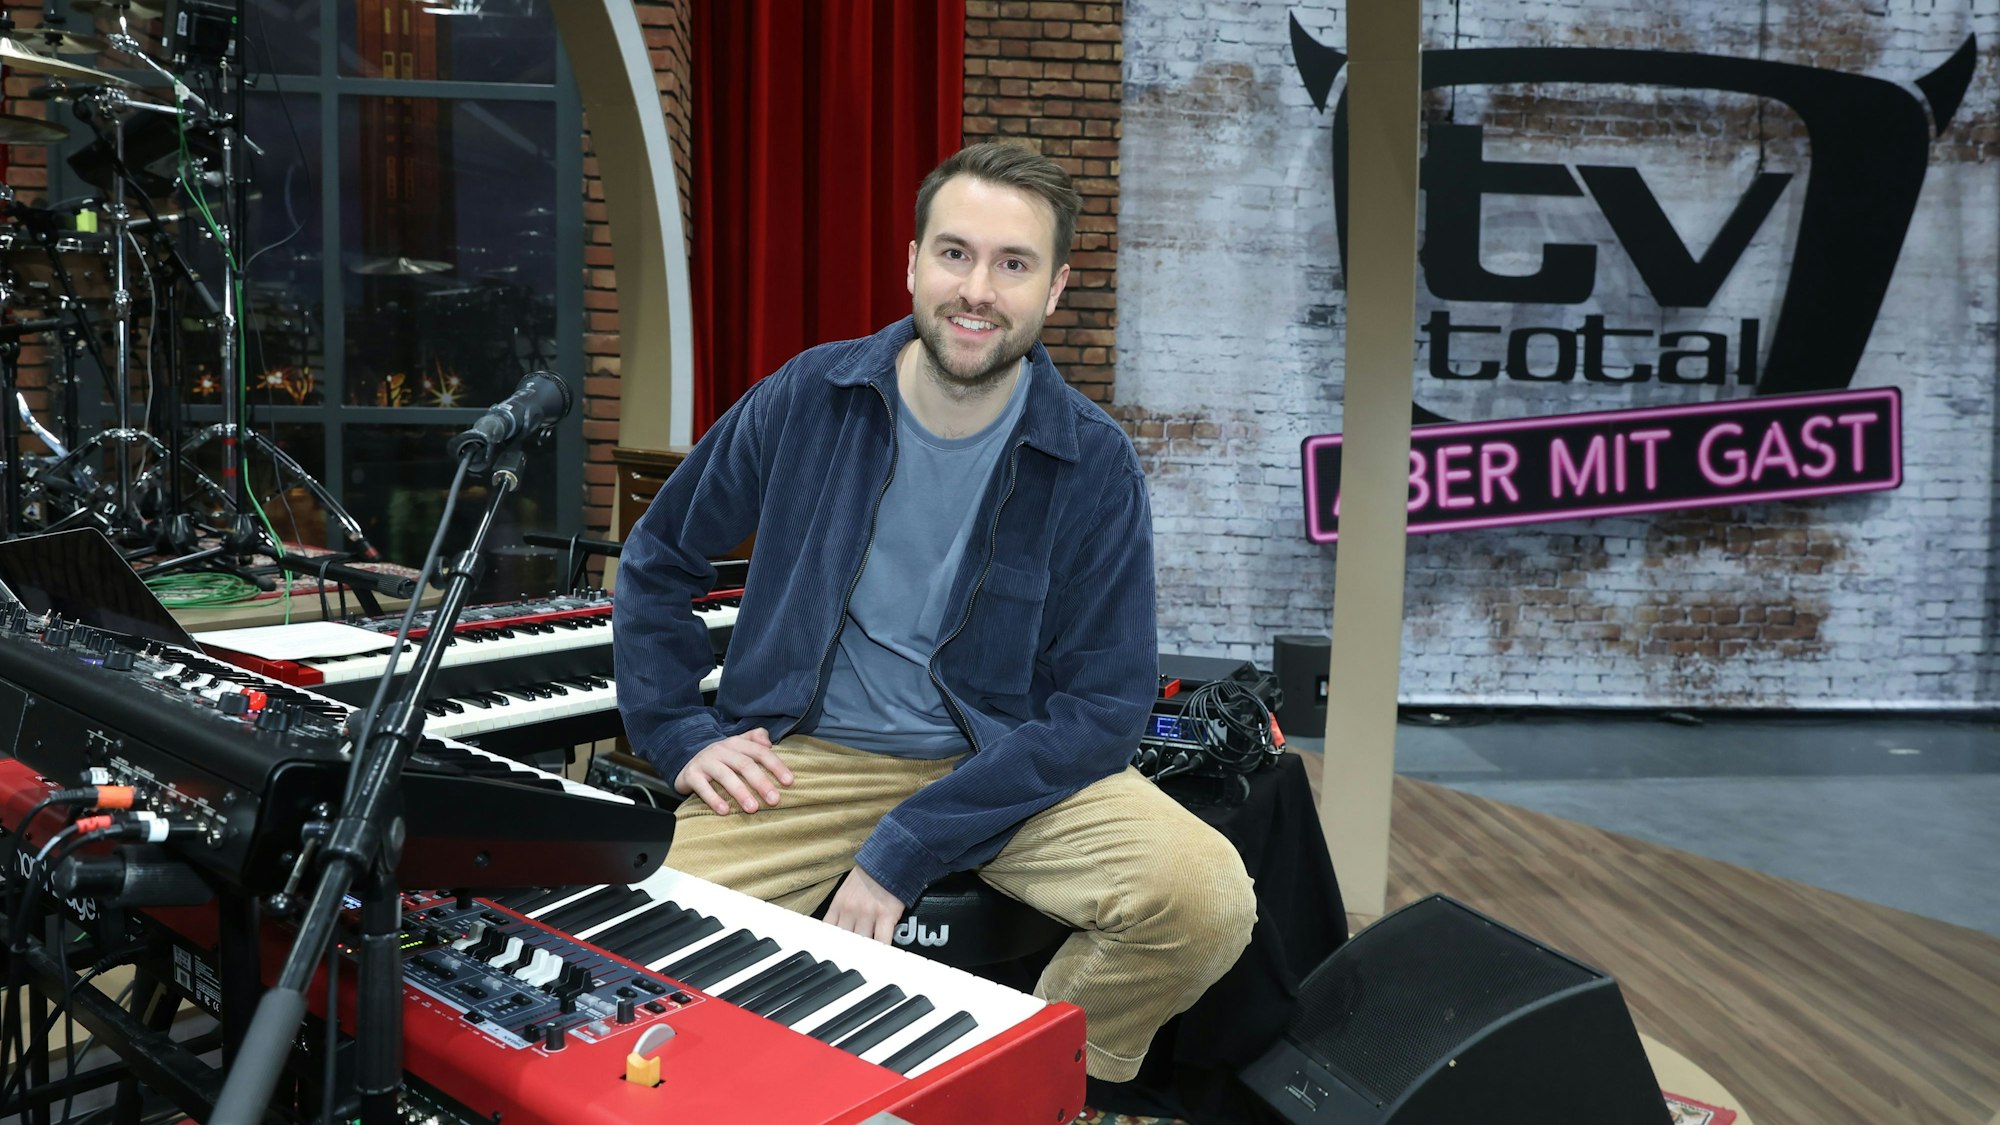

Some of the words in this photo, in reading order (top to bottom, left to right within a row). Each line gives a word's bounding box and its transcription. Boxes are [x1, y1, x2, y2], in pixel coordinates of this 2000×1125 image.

[1419, 124, 1793, 308] tv
[1422, 311, 1760, 386] total
[1333, 443, 1519, 517] BER
[1551, 429, 1671, 497] MIT
[1697, 412, 1878, 484] GAST
[893, 916, 950, 947] dw
